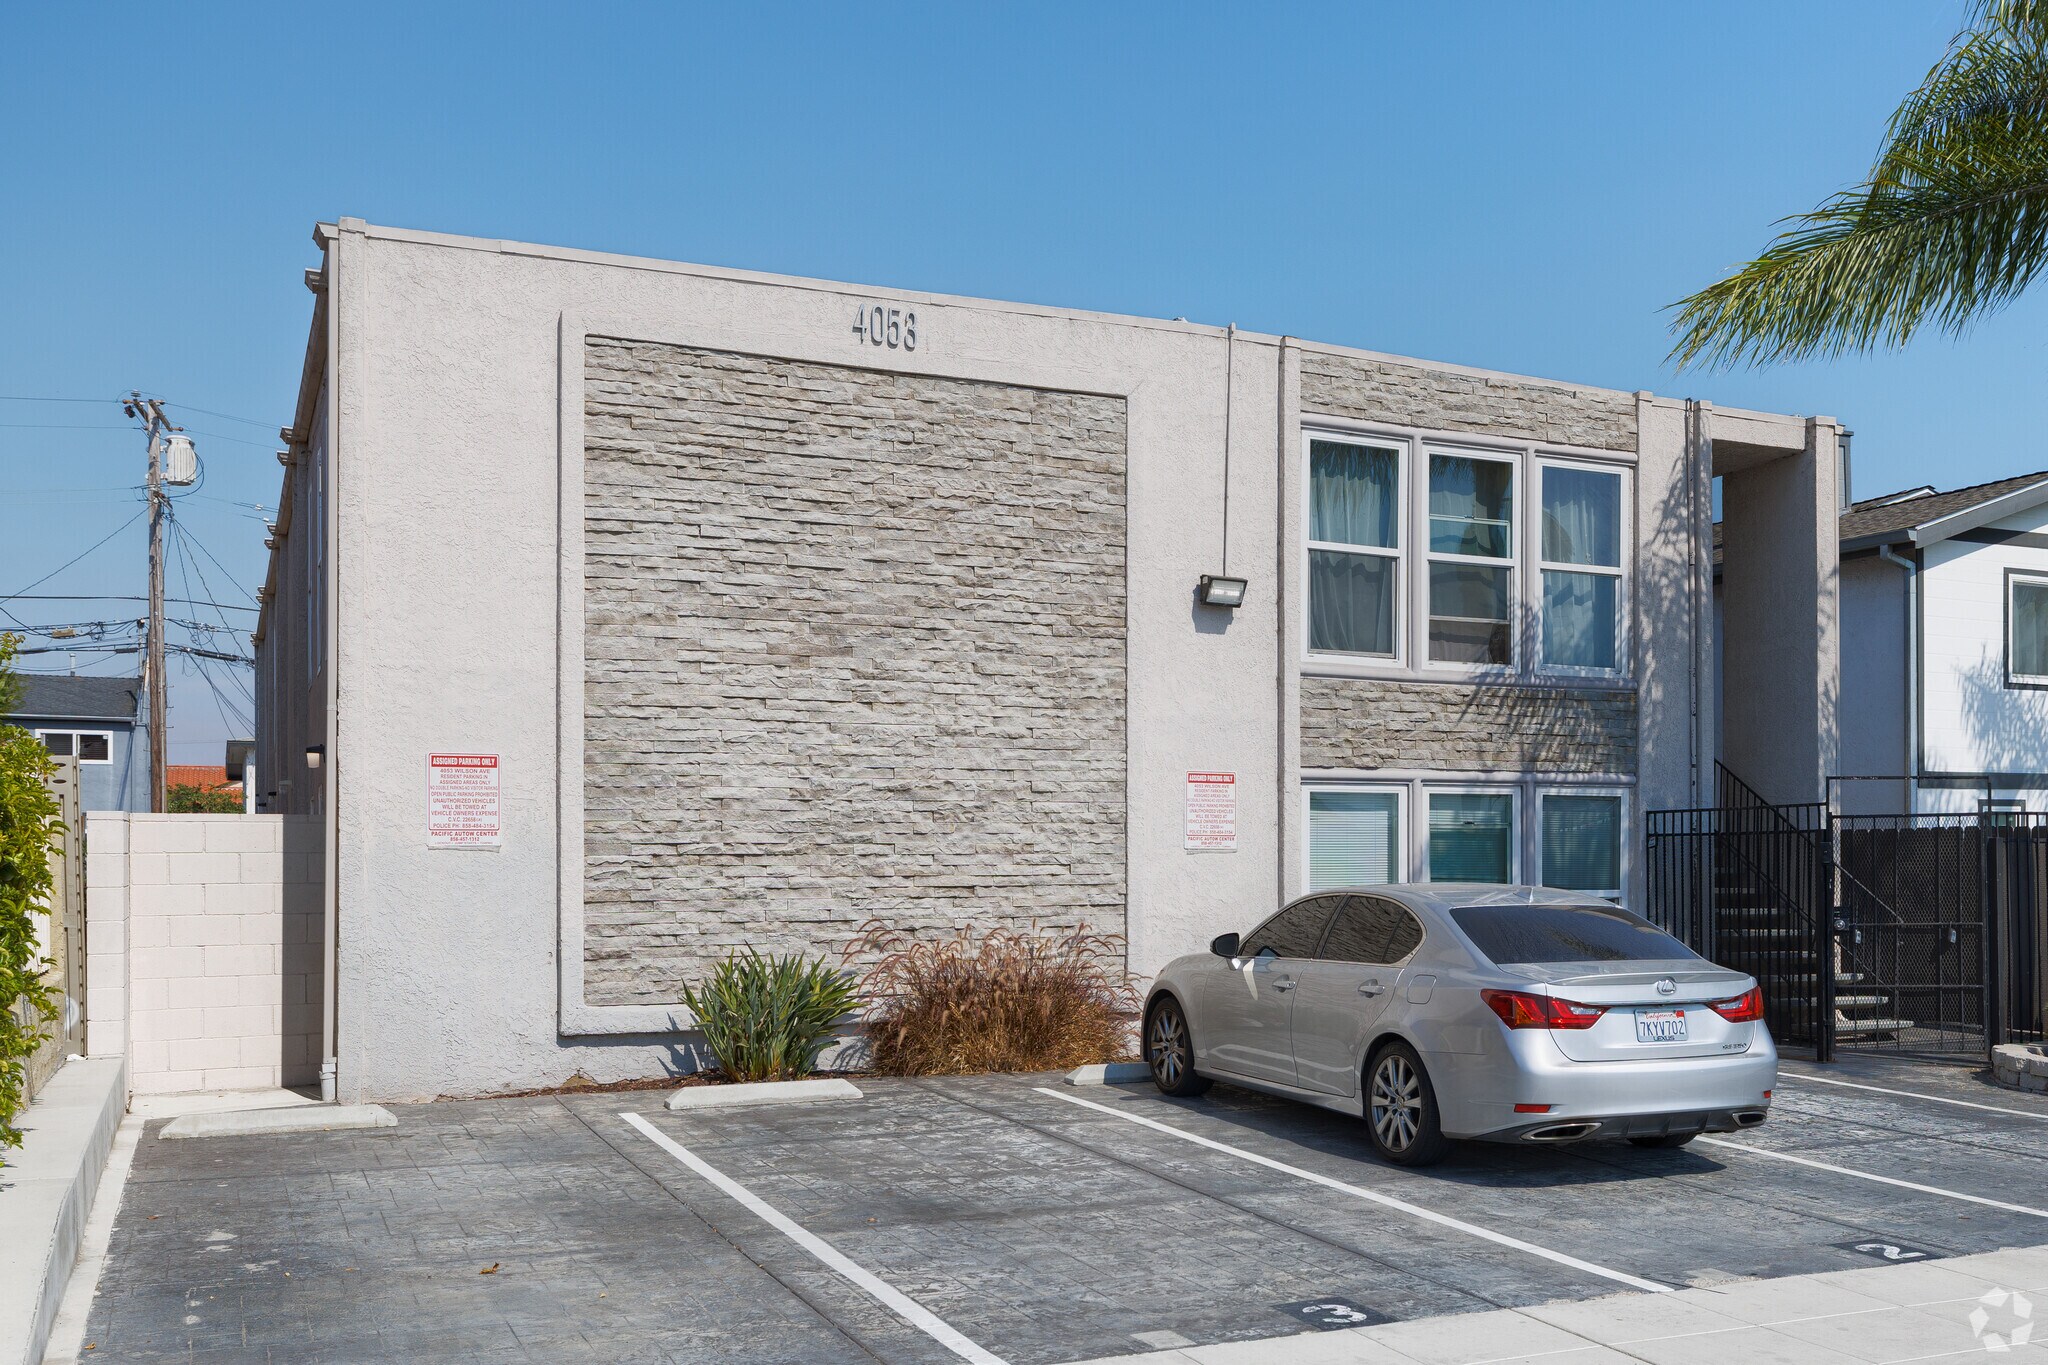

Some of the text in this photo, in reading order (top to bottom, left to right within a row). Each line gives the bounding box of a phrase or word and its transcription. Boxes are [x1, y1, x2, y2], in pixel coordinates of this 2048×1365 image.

[852, 303, 917, 352] 4053
[1640, 1021, 1684, 1036] 7KYV702
[1855, 1244, 1926, 1259] 2
[1302, 1304, 1367, 1323] 3
